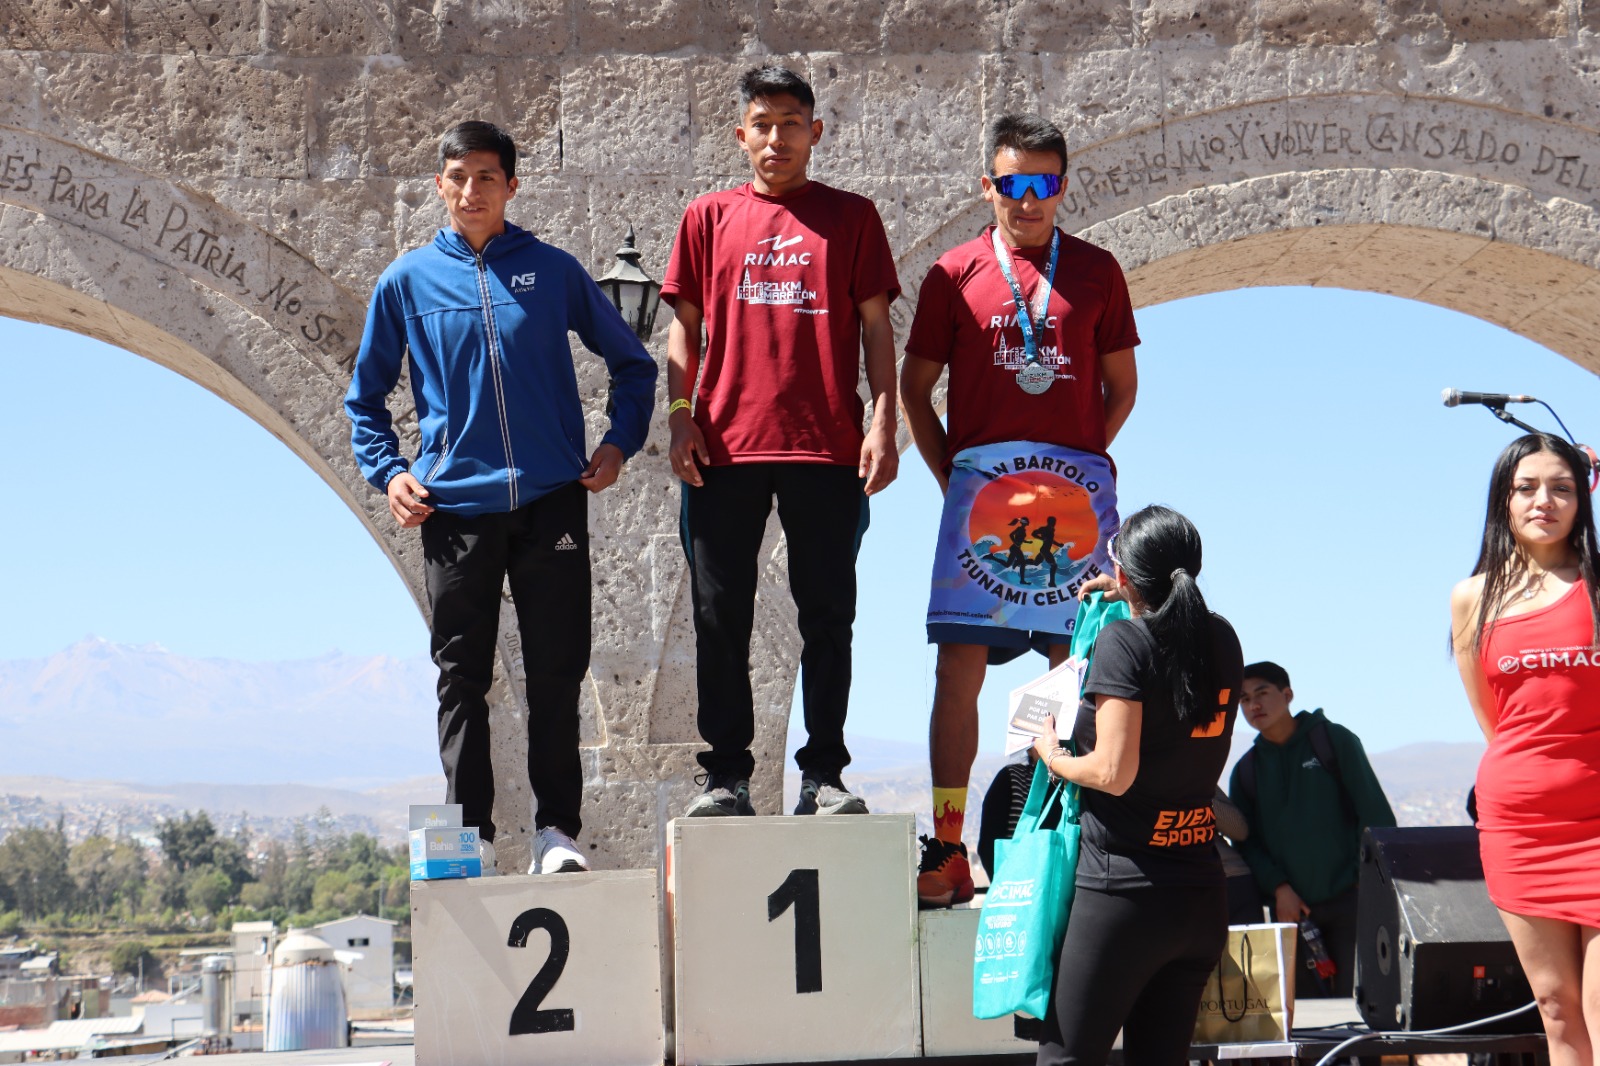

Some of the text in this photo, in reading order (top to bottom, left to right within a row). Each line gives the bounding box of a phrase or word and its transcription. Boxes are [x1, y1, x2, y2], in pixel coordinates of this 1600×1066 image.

[1226, 120, 1249, 161] Y
[1260, 120, 1361, 161] VOLVER
[1365, 112, 1520, 165] CANSADO
[1531, 144, 1593, 193] DEL
[0, 154, 41, 192] ES
[51, 165, 109, 220] PARA
[120, 187, 149, 231] LA
[744, 252, 811, 267] RIMAC
[764, 289, 817, 300] MARATÓN
[990, 315, 1058, 329] RIC
[1013, 455, 1100, 494] BARTOLO
[554, 543, 578, 551] adidas
[957, 548, 1028, 606] TSUNAMI
[459, 832, 475, 843] 100
[1149, 824, 1216, 847] SPORT
[999, 884, 1034, 900] CIMAC
[767, 868, 823, 994] 1
[507, 906, 576, 1036] 2
